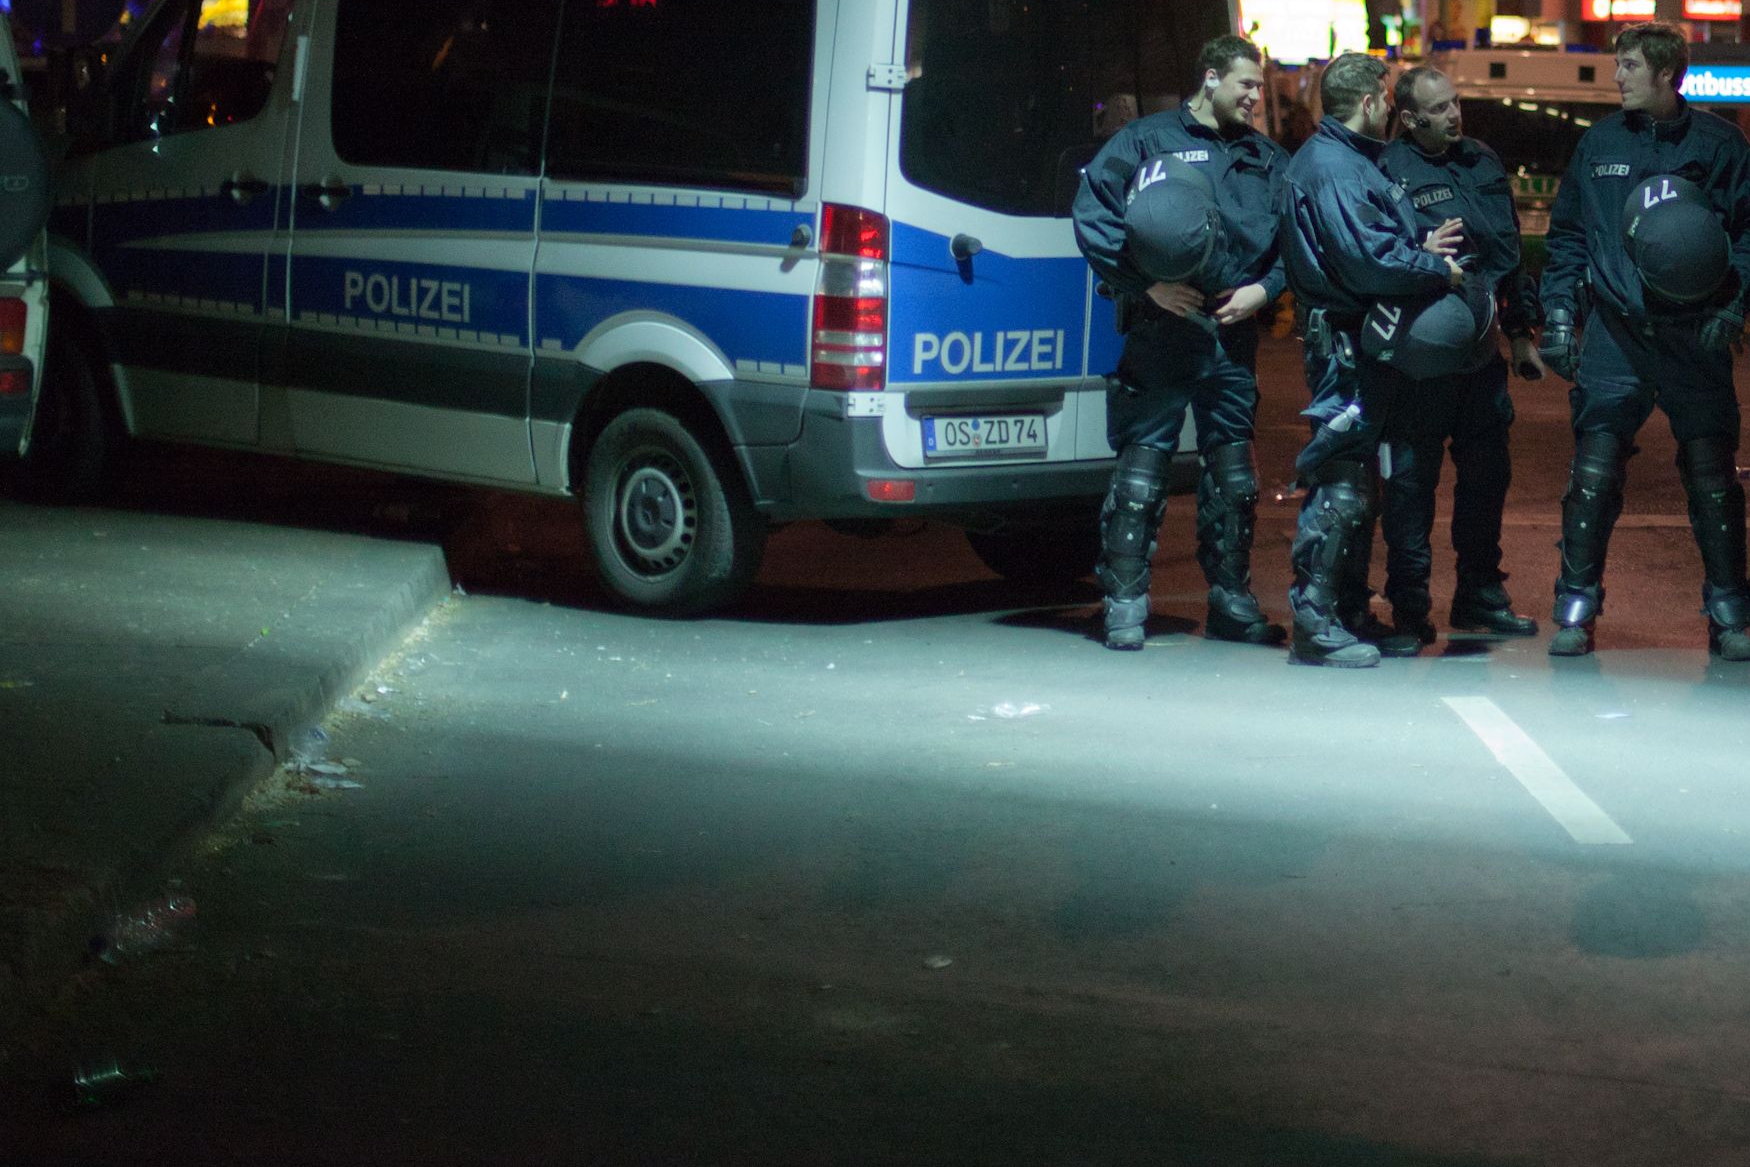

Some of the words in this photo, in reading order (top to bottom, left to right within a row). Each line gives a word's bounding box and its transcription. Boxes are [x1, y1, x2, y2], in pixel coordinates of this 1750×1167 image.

[1172, 150, 1209, 162] LIZEI
[1591, 163, 1630, 178] POLIZEI
[1412, 187, 1454, 209] POLIZEI
[344, 270, 471, 323] POLIZEI
[913, 329, 1065, 375] POLIZEI
[945, 420, 972, 447] OS
